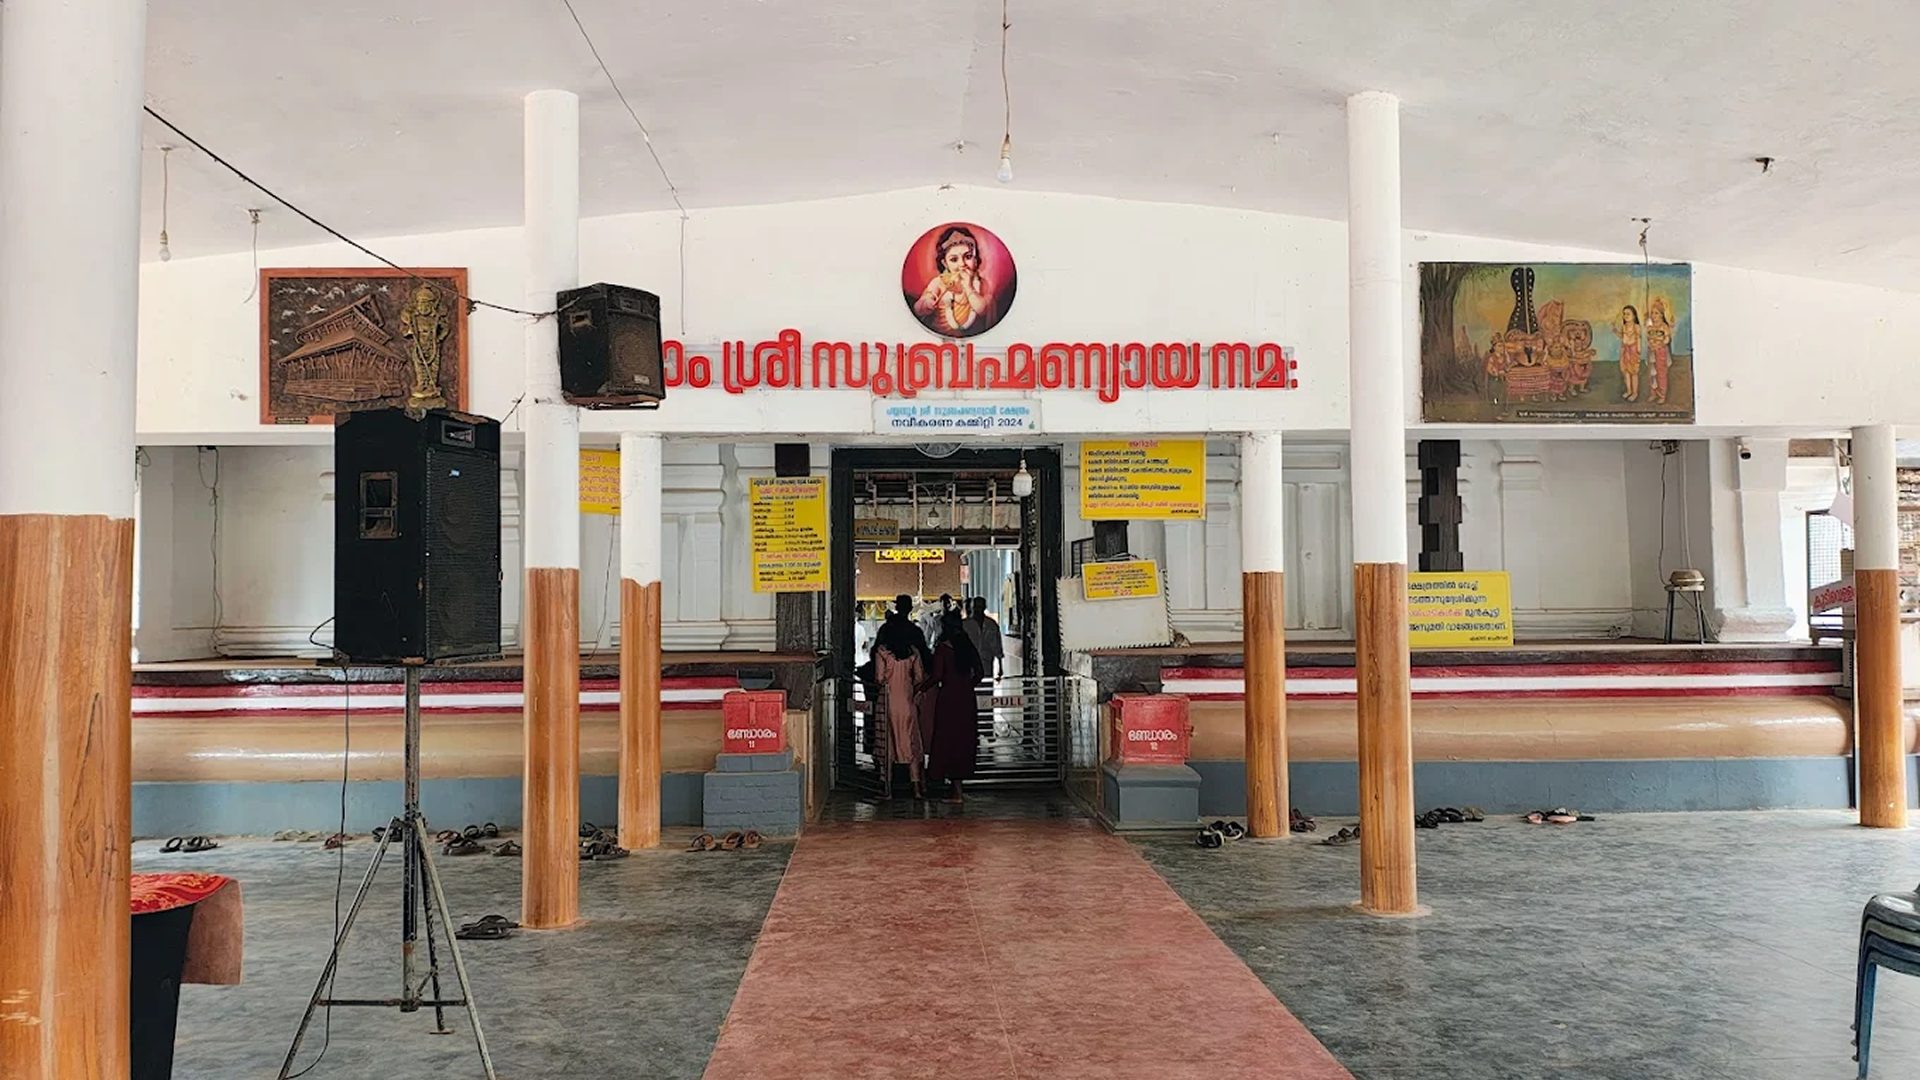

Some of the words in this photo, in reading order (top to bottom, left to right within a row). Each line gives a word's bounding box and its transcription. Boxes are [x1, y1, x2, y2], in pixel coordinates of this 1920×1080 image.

[722, 328, 803, 394] ശ്രീ
[811, 341, 1202, 403] സുബ്രഹ്മണ്യായ
[891, 417, 953, 427] നവീകരണ
[997, 418, 1023, 427] 2024
[990, 696, 1024, 706] PULL
